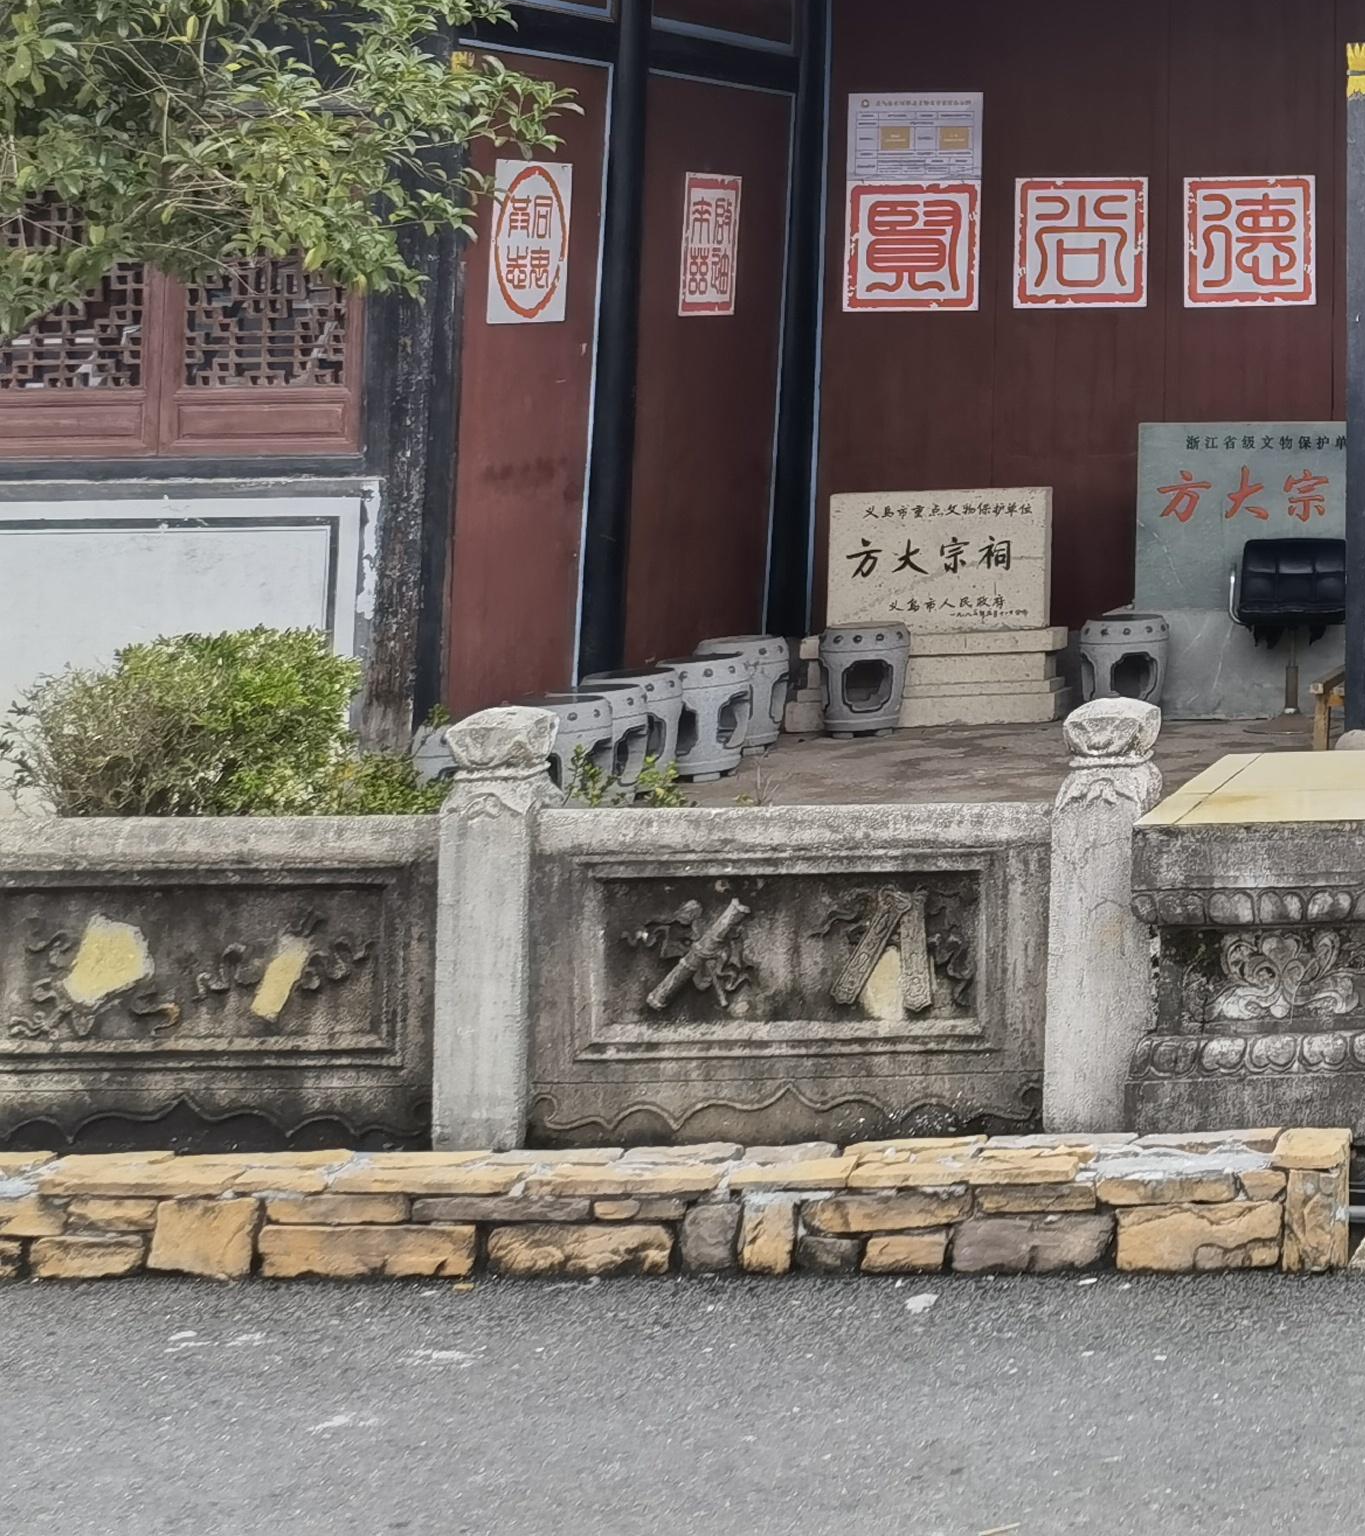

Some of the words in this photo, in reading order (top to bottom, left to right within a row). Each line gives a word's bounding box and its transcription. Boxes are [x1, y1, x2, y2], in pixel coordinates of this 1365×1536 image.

[1202, 193, 1297, 287] 德
[1157, 465, 1329, 522] 方大宗
[846, 535, 1011, 579] 方大宗祠
[889, 593, 1006, 612] 义乌市人民政府
